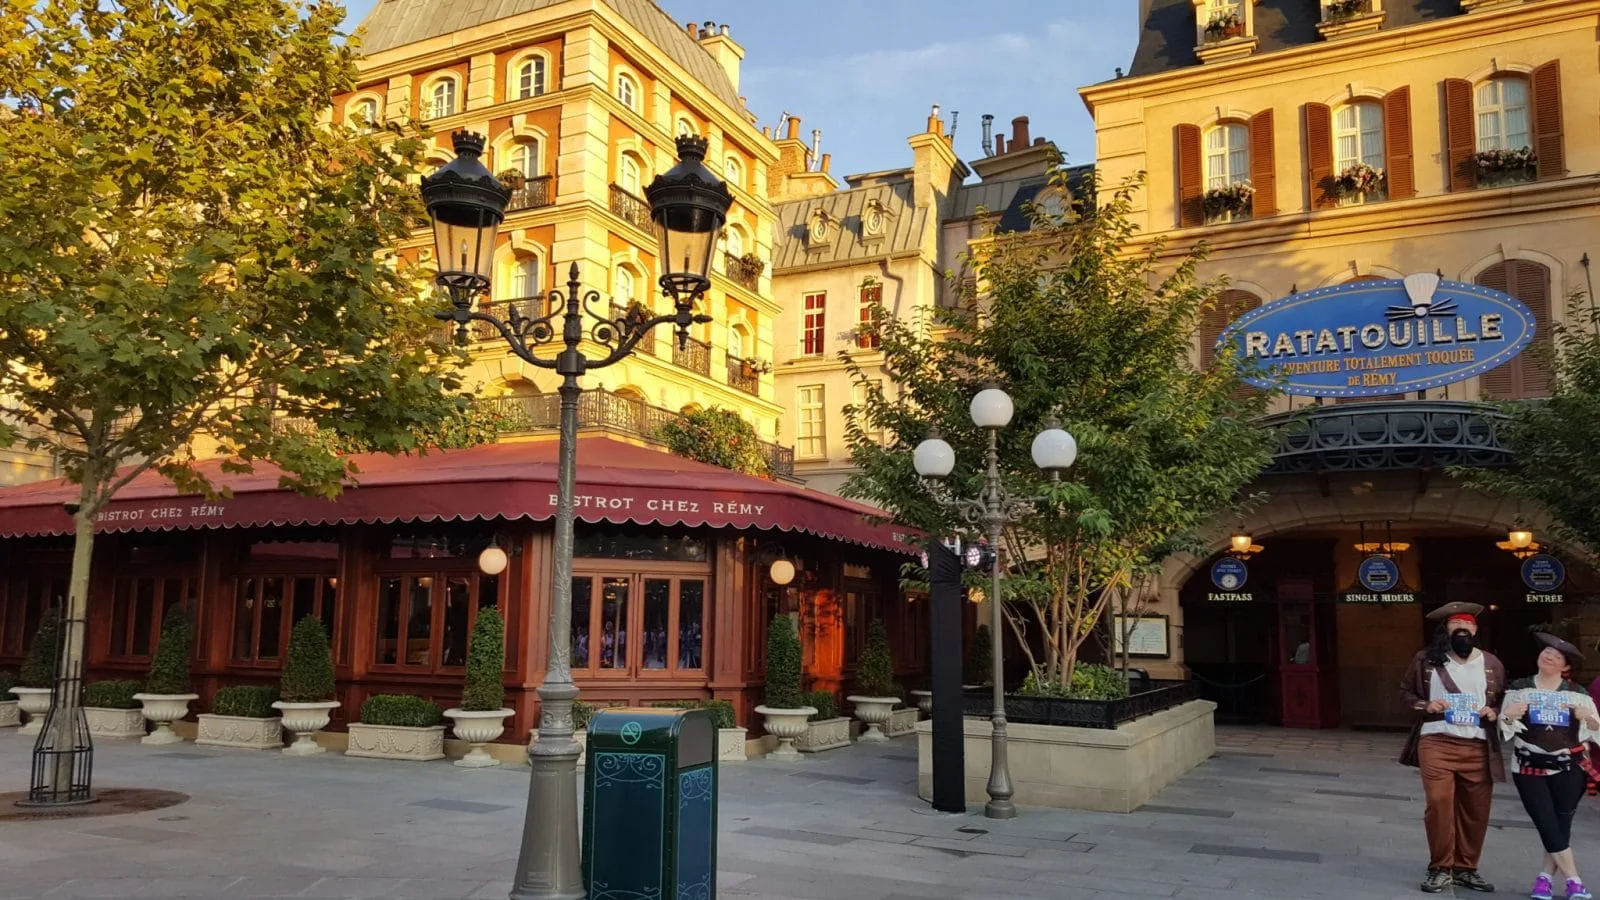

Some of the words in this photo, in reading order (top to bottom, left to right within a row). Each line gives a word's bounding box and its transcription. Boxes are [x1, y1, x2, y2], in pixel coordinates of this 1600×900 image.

[1246, 313, 1504, 358] RATATOUILLE
[1344, 352, 1422, 371] TOTALEMENT
[1348, 376, 1361, 387] DE
[1363, 370, 1397, 387] RÉMY
[98, 509, 145, 522] BISTROT
[151, 507, 183, 519] CHEZ
[191, 503, 225, 517] RÉMY
[548, 494, 634, 510] BSTROT
[646, 499, 699, 513] CHEZ
[713, 500, 765, 516] RÉMY
[1208, 592, 1253, 601] FASTPASS
[1345, 593, 1379, 602] SINGLE
[1381, 593, 1415, 602] RIDERS
